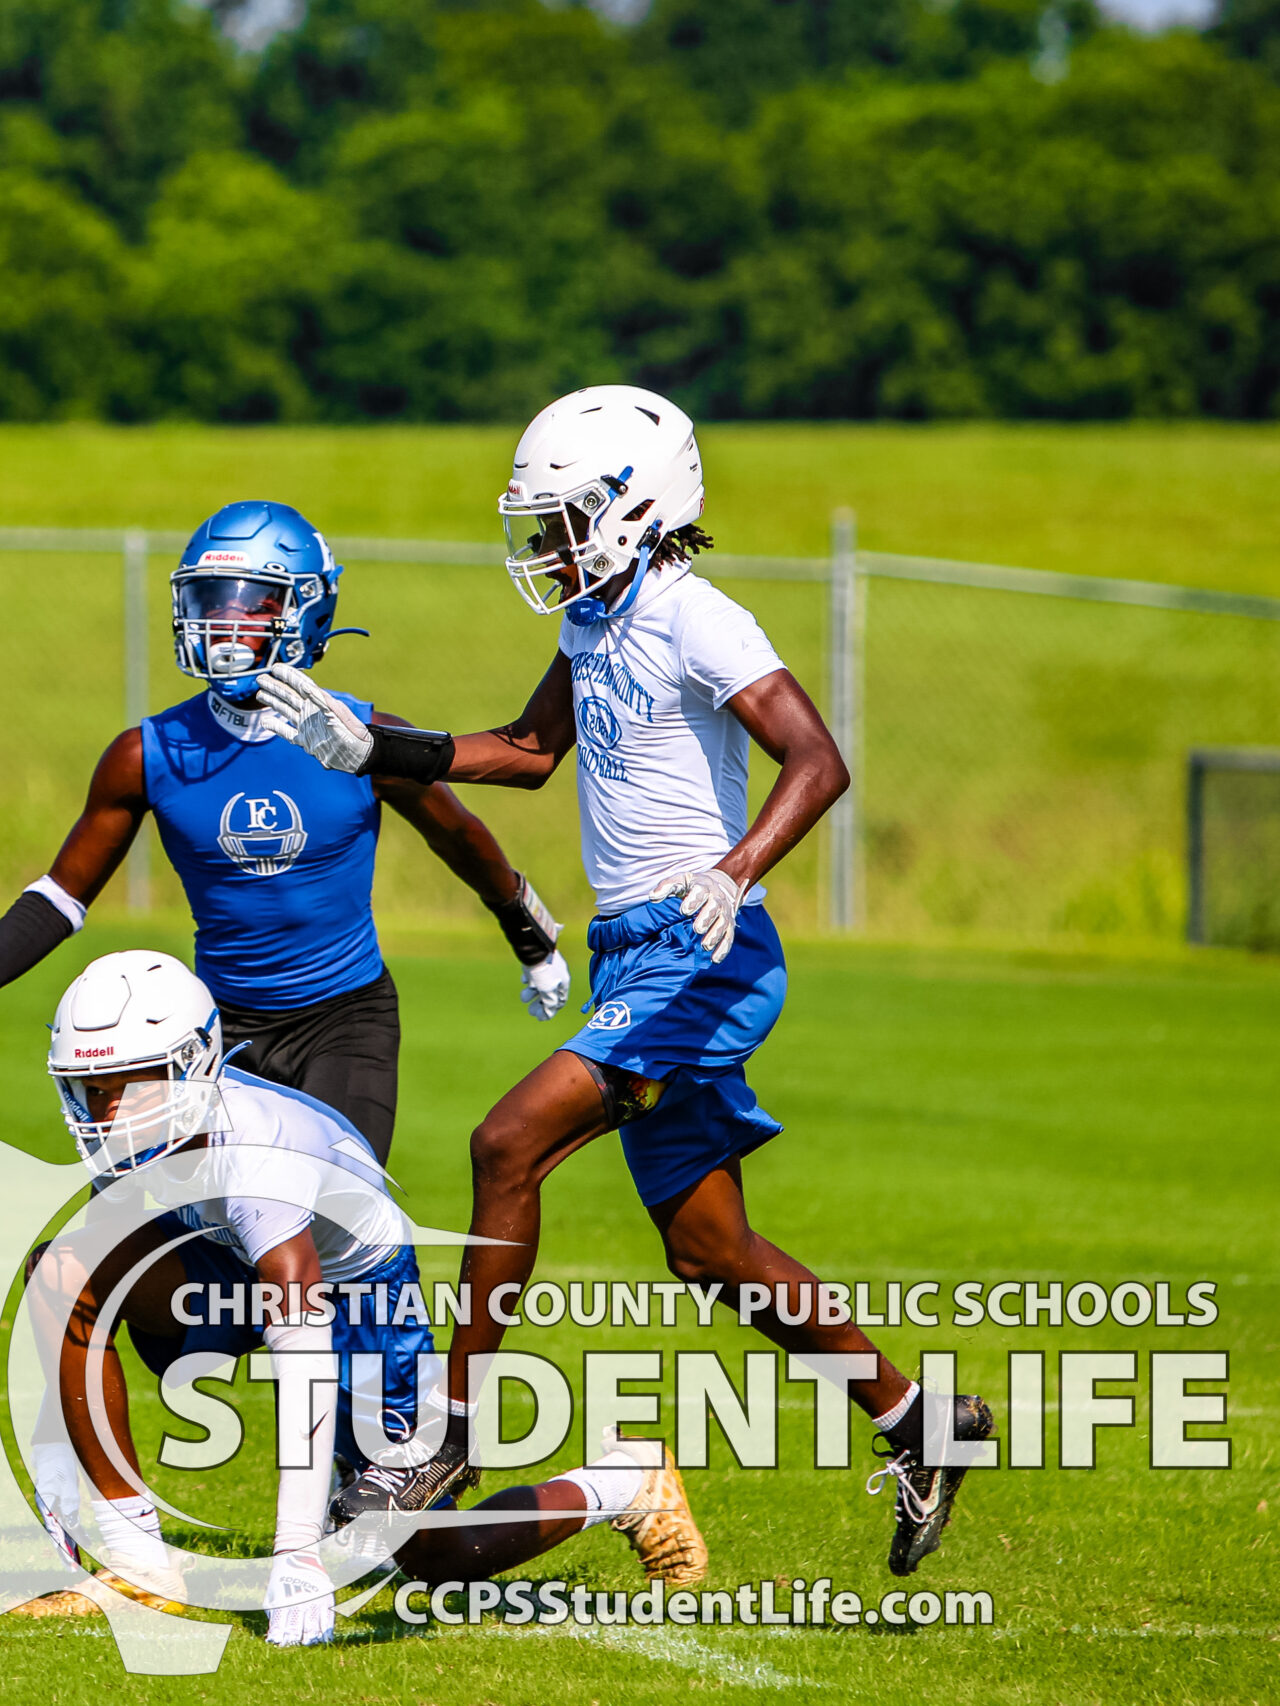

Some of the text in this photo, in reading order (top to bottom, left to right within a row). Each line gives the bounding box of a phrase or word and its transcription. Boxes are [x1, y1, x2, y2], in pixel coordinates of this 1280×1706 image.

[219, 706, 249, 728] FTBL
[244, 798, 278, 830] FC
[74, 1046, 115, 1058] Riddell
